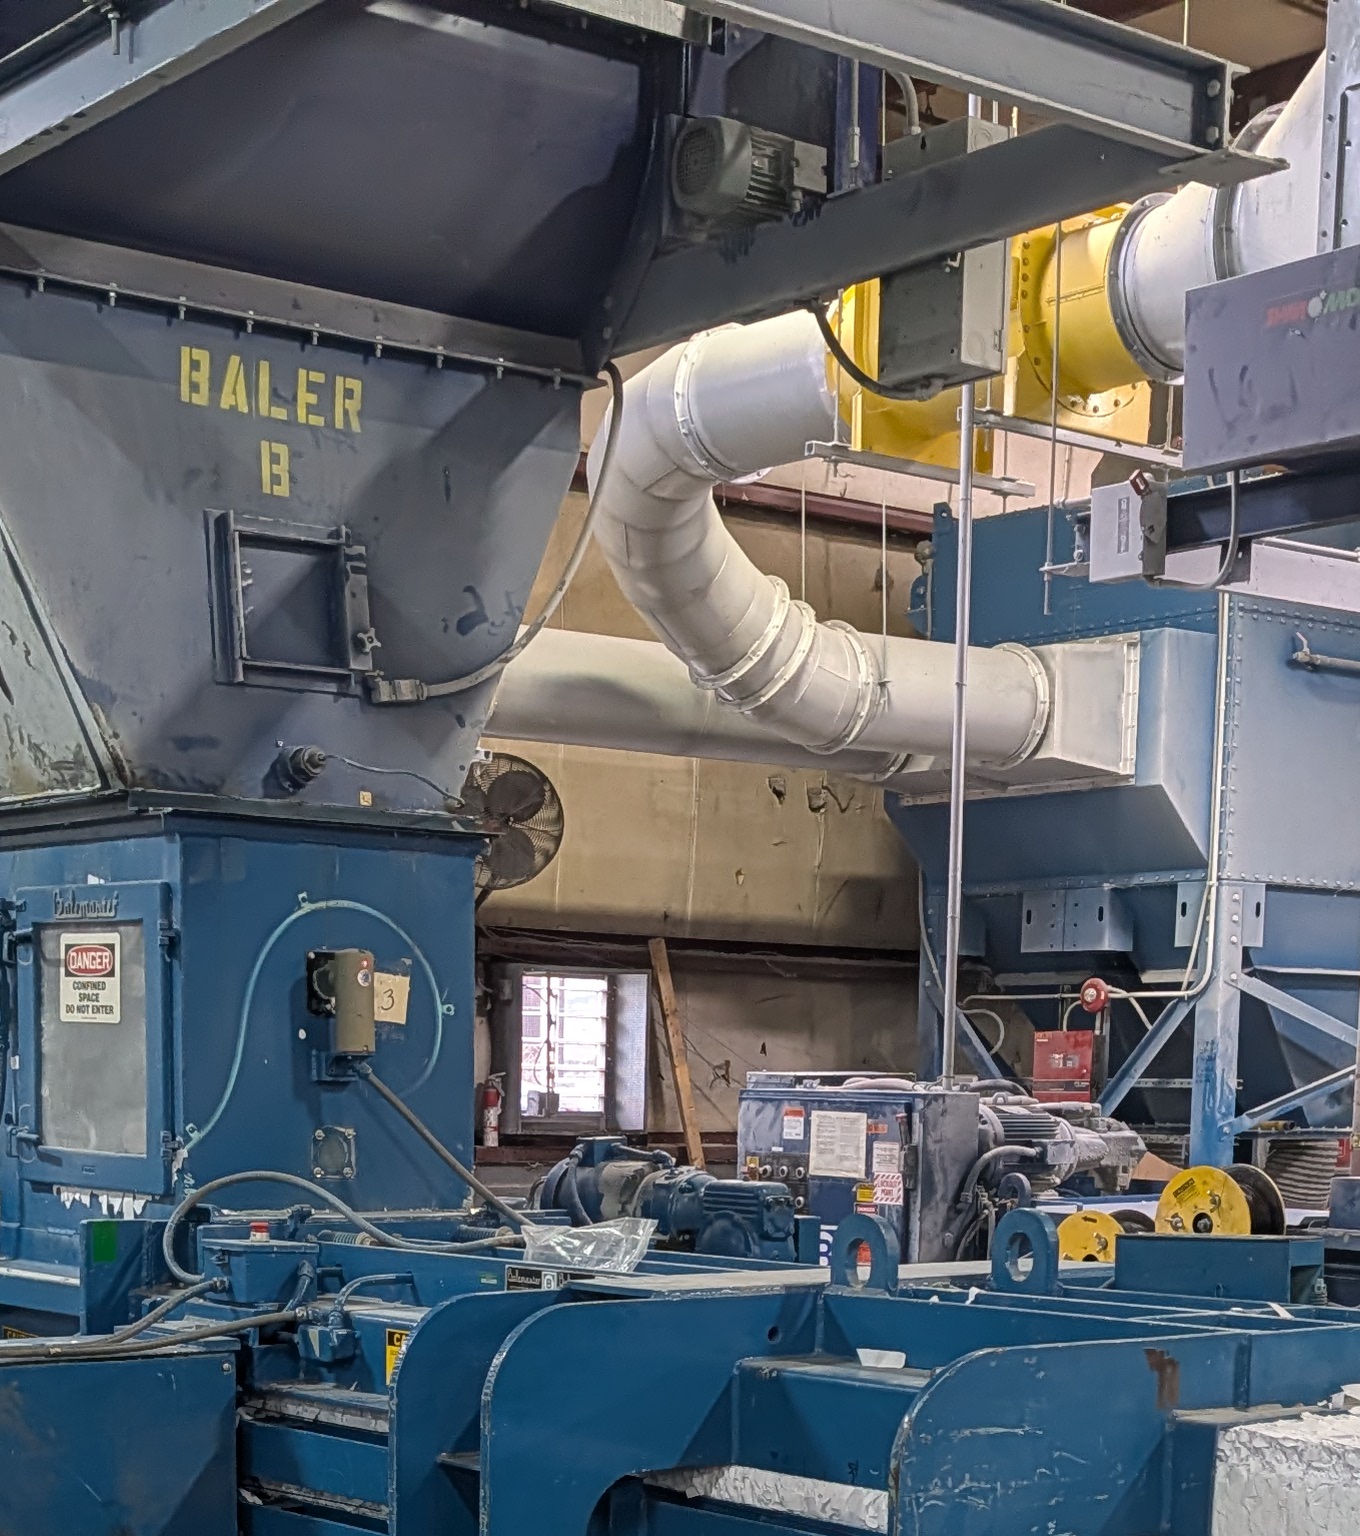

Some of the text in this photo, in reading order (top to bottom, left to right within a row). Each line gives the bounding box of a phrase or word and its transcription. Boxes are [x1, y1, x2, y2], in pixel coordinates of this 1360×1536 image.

[180, 345, 362, 433] BALER
[260, 440, 290, 498] B
[69, 951, 111, 969] DANGER
[72, 981, 107, 991] CONFINED
[78, 993, 100, 1003] SPACE
[381, 988, 395, 1011] 3
[66, 1004, 114, 1015] DO NOT ENTER
